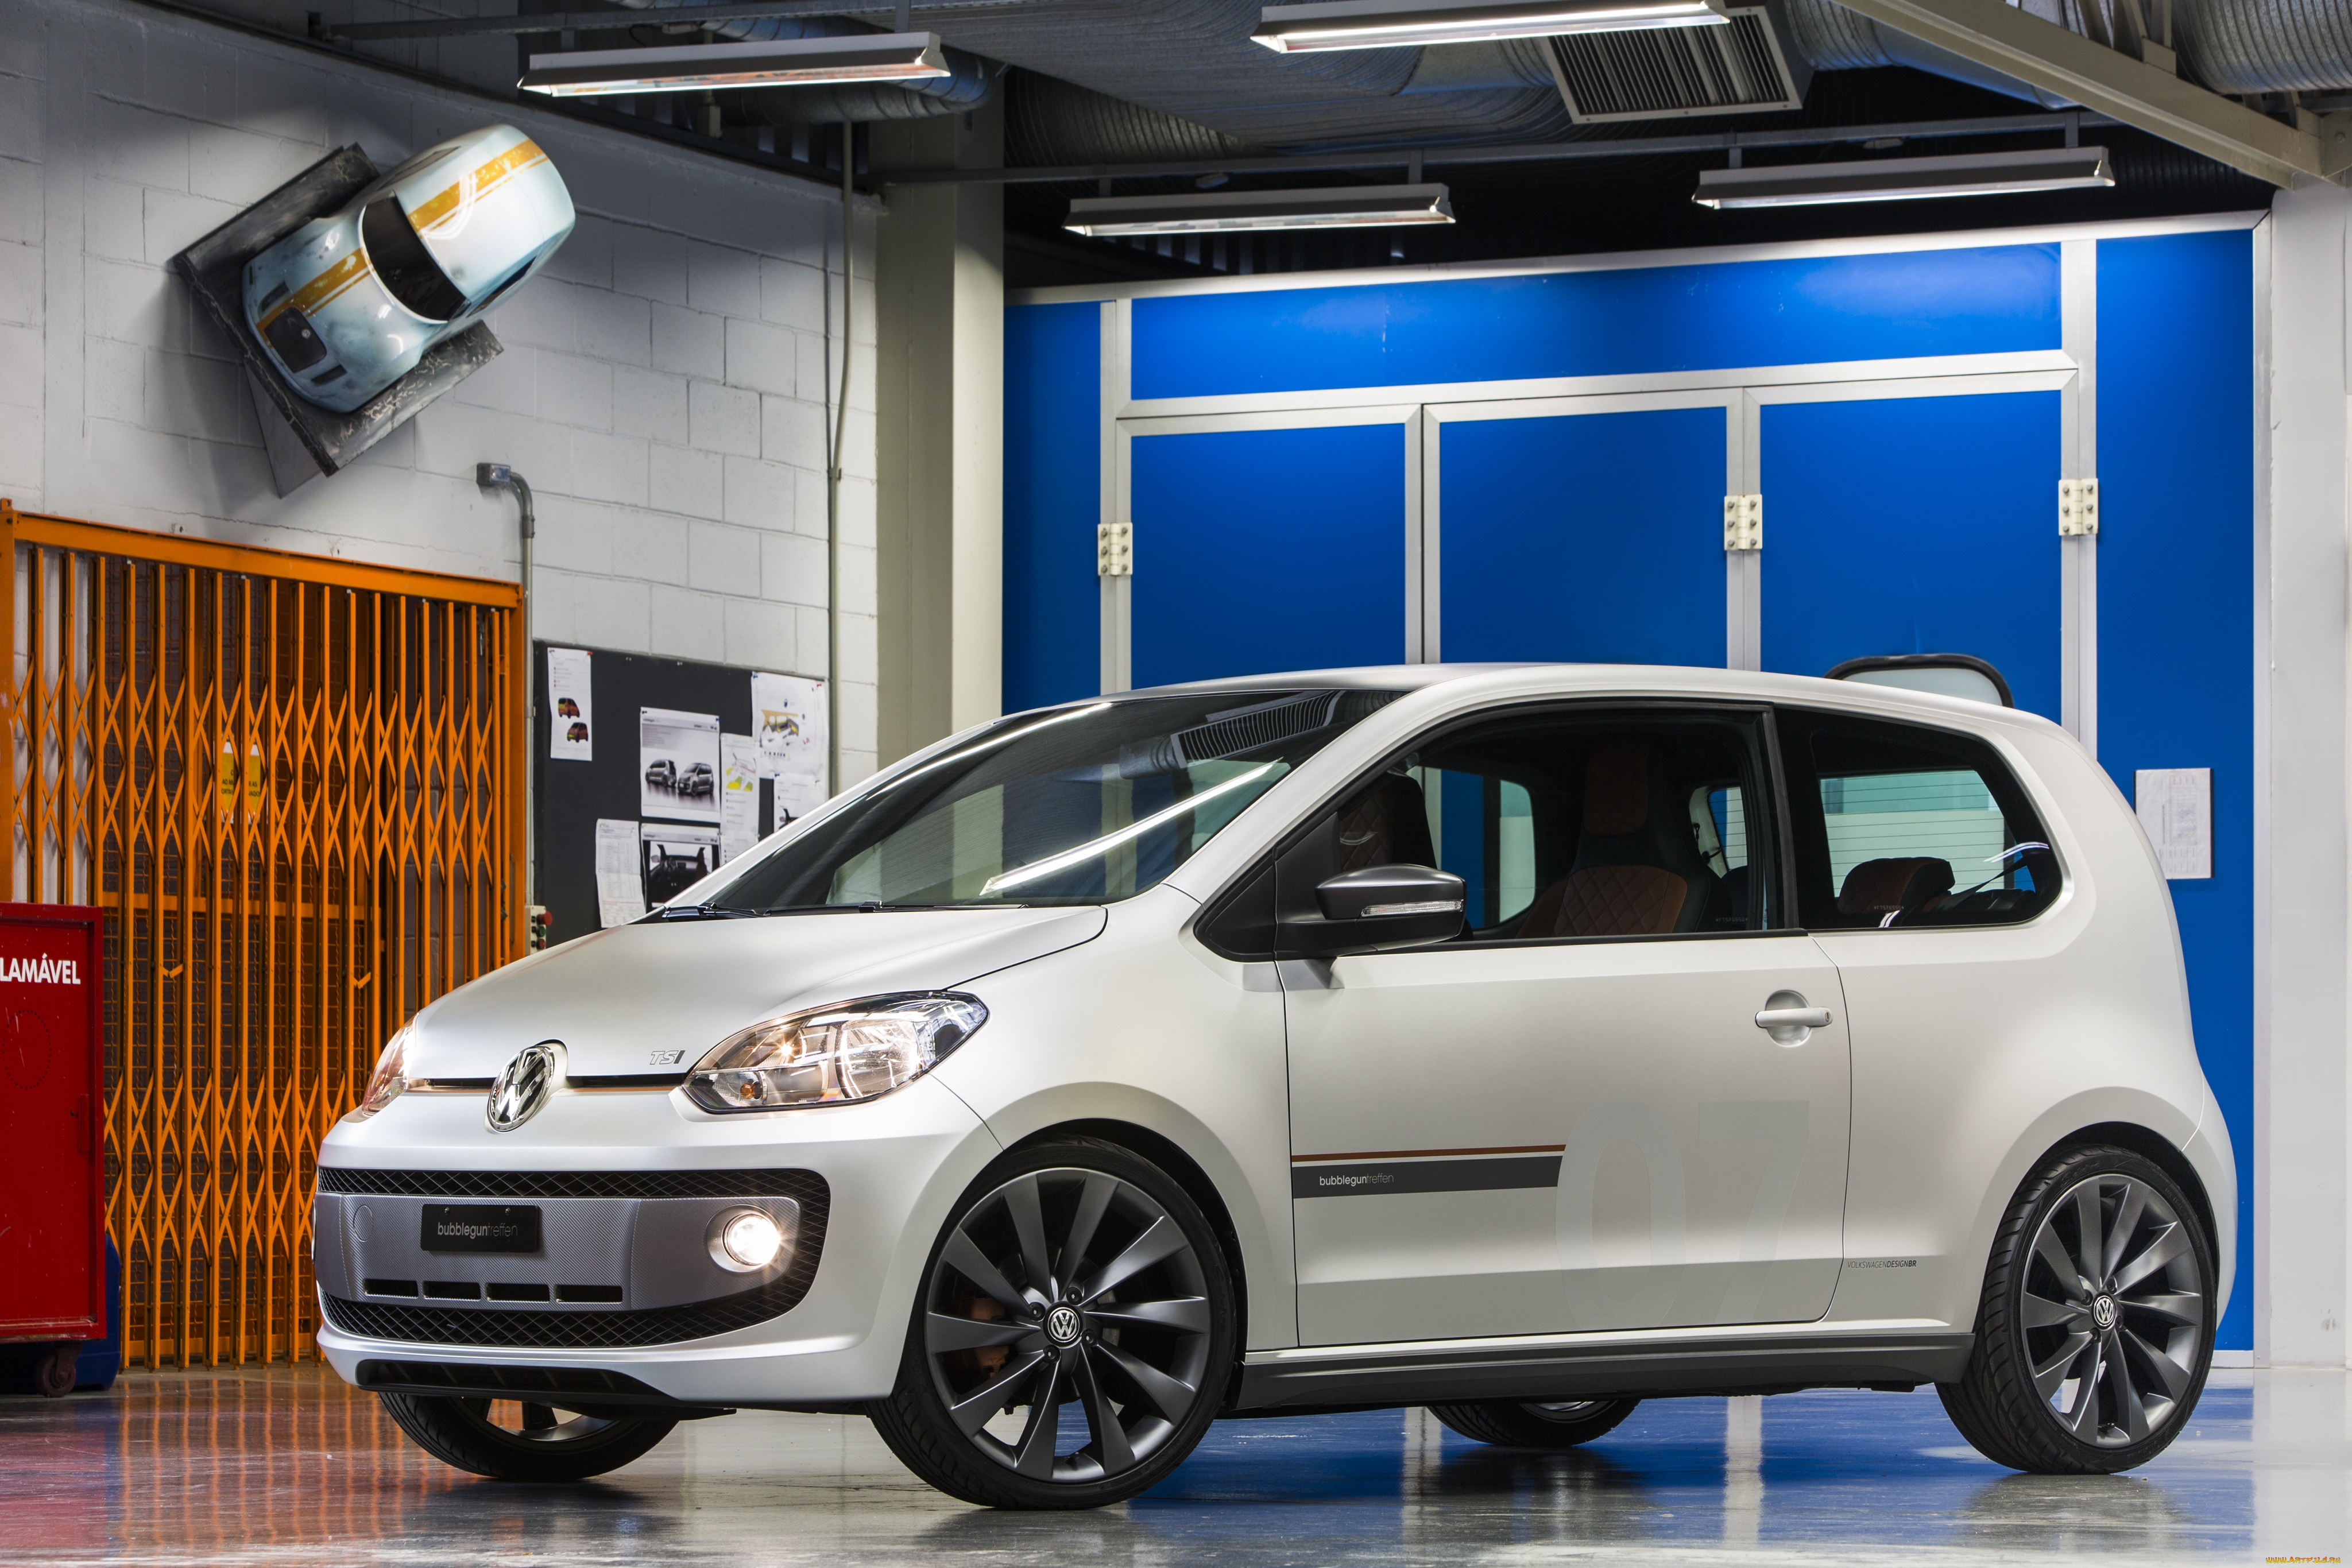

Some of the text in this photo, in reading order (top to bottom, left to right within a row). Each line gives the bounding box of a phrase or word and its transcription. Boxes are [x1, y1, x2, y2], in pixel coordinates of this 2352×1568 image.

[649, 1050, 686, 1065] TSI
[1319, 1172, 1394, 1187] bubbleguntreffen
[437, 1222, 518, 1240] bubbleguntreffen
[1847, 1260, 1917, 1269] VOLKSWAGENDESIGNBR
